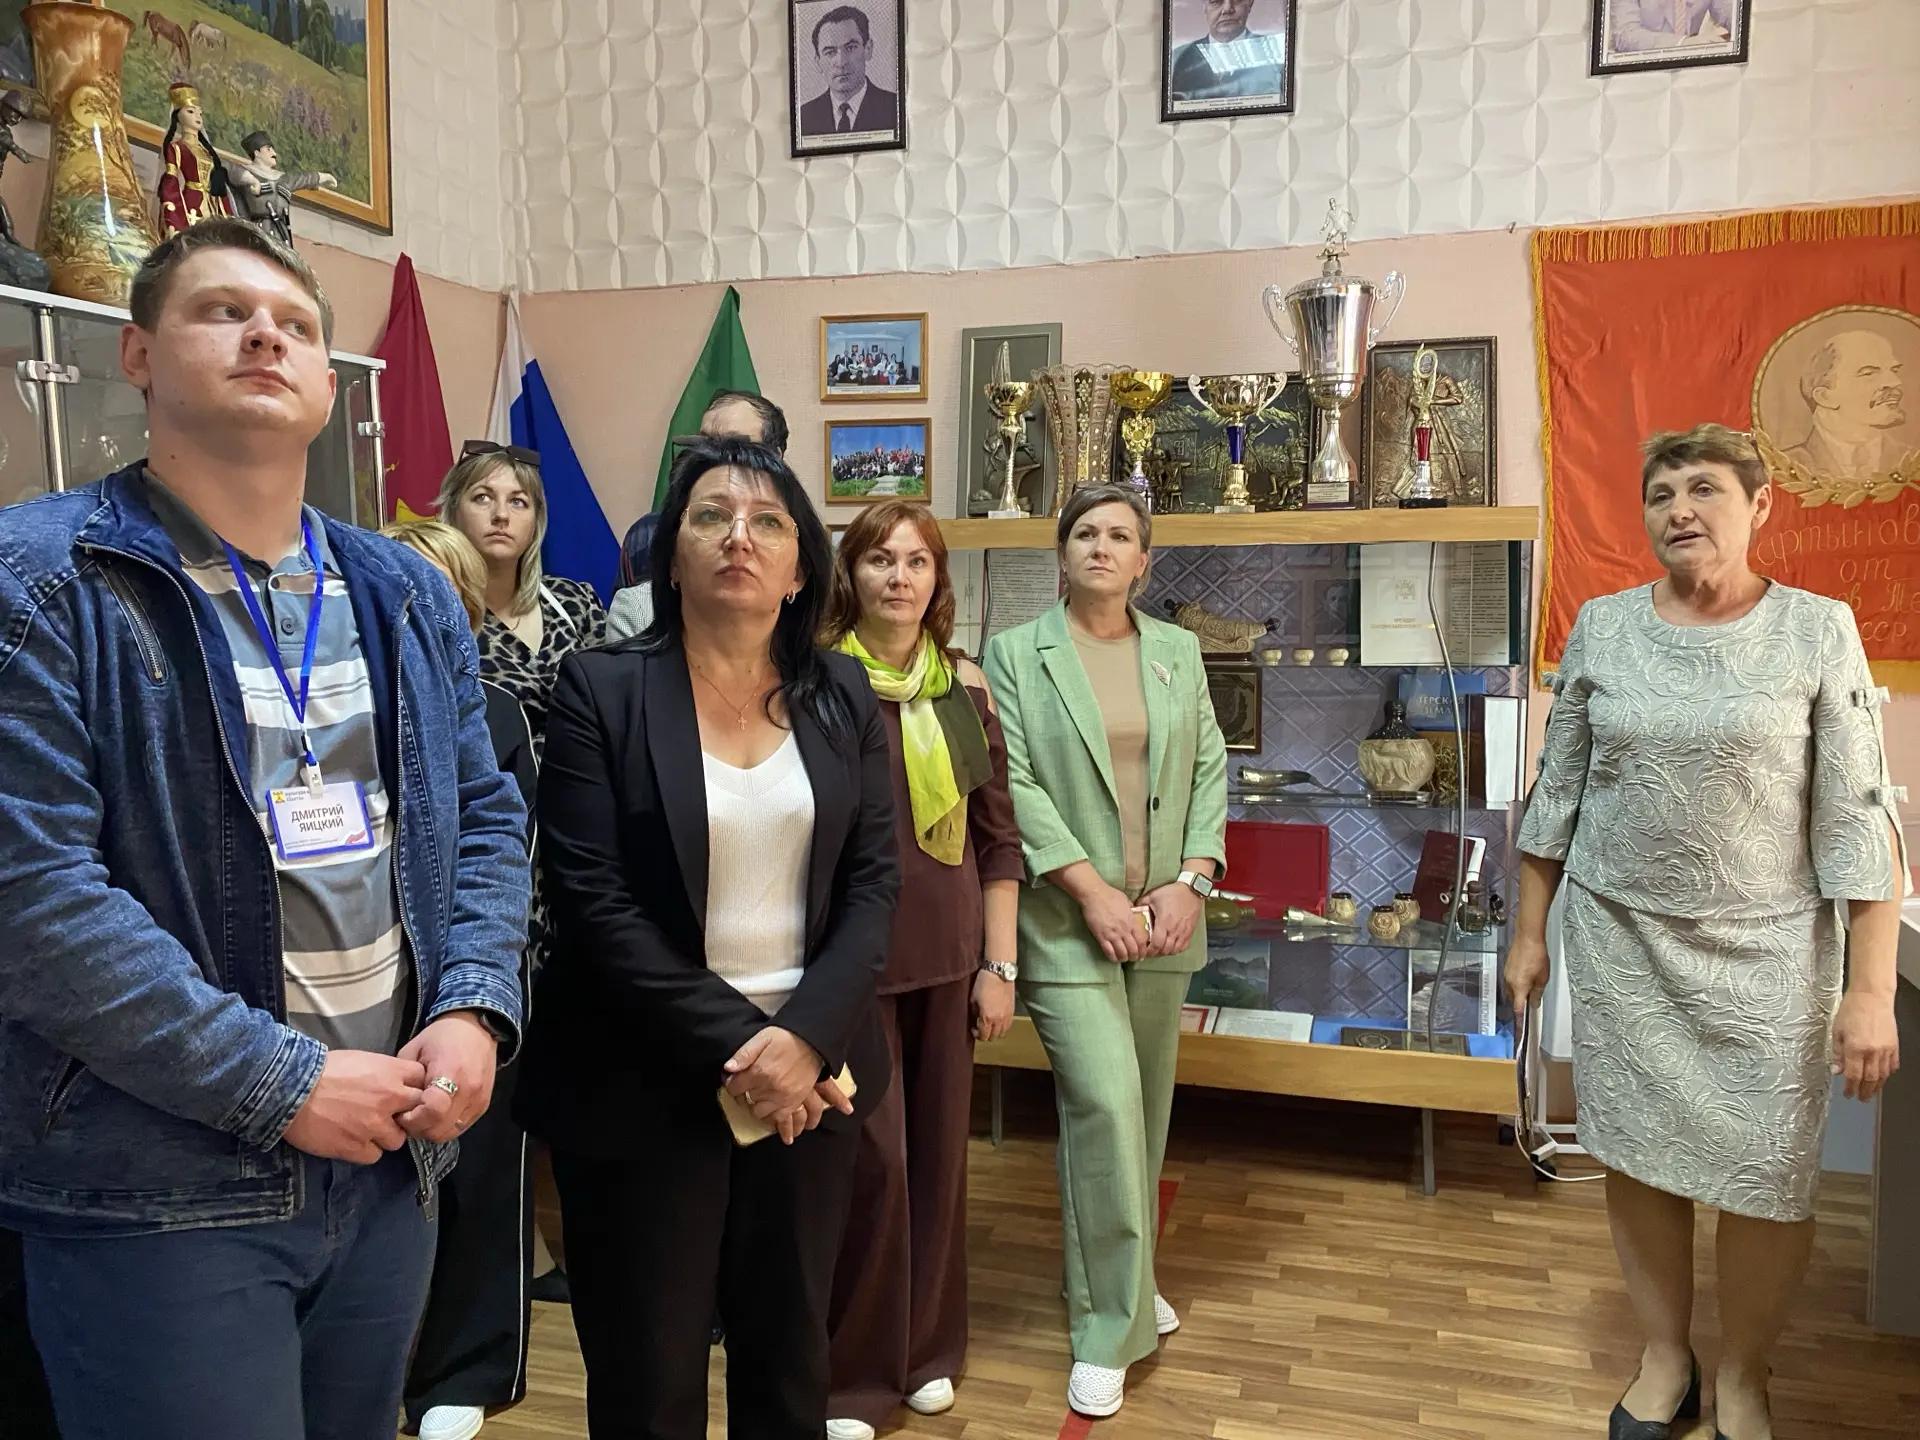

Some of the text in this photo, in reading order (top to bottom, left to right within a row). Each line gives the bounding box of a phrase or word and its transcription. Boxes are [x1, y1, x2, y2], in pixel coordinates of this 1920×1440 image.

[1840, 558, 1892, 584] от
[1419, 695, 1465, 705] ТЕРСКЯ
[291, 803, 344, 823] ДМИТРИЙ
[299, 816, 344, 832] ЯИЦКИЙ
